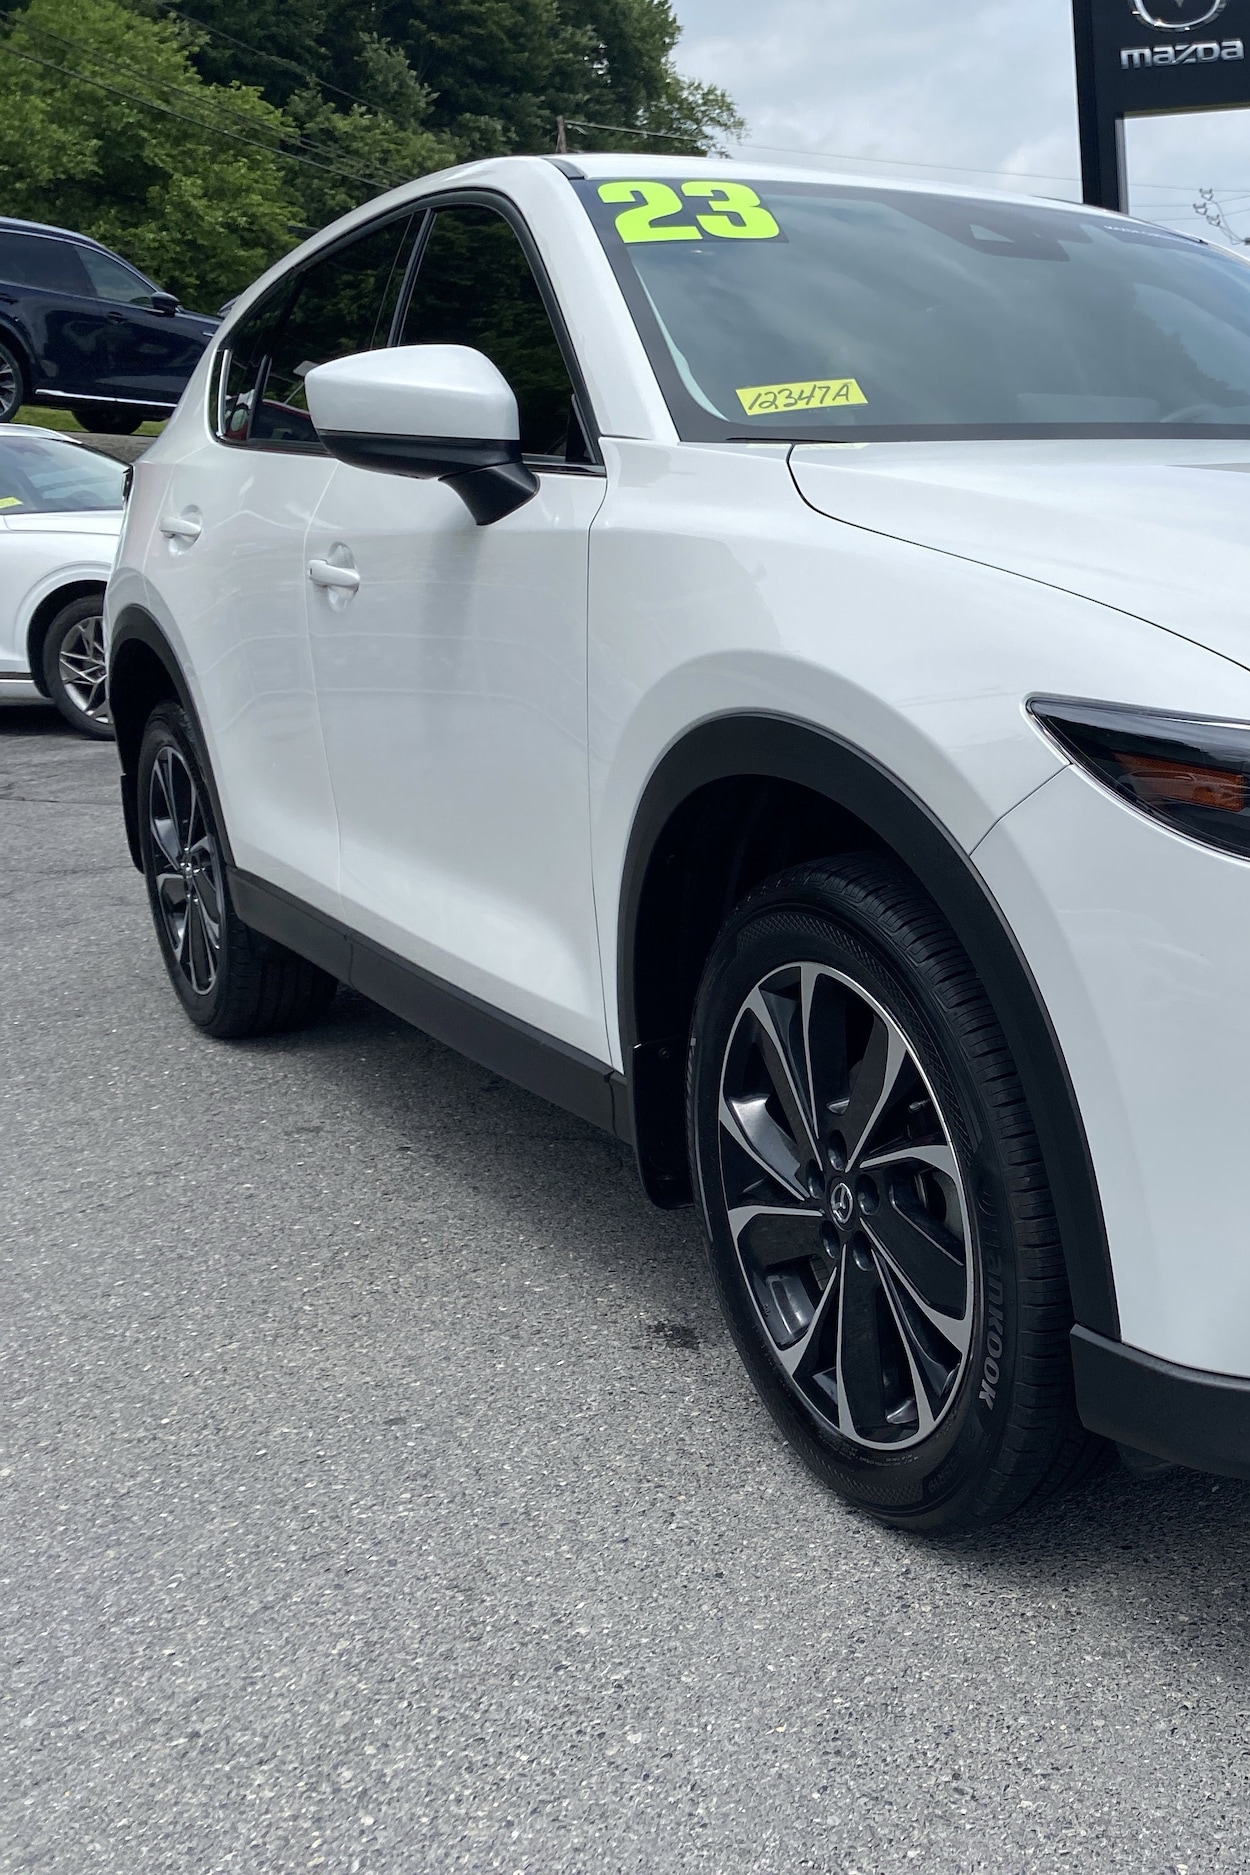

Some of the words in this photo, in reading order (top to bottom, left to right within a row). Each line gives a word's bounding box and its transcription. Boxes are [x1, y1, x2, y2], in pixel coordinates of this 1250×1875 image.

[1120, 38, 1245, 69] mazda
[597, 181, 780, 244] 23
[747, 383, 853, 410] 12347A
